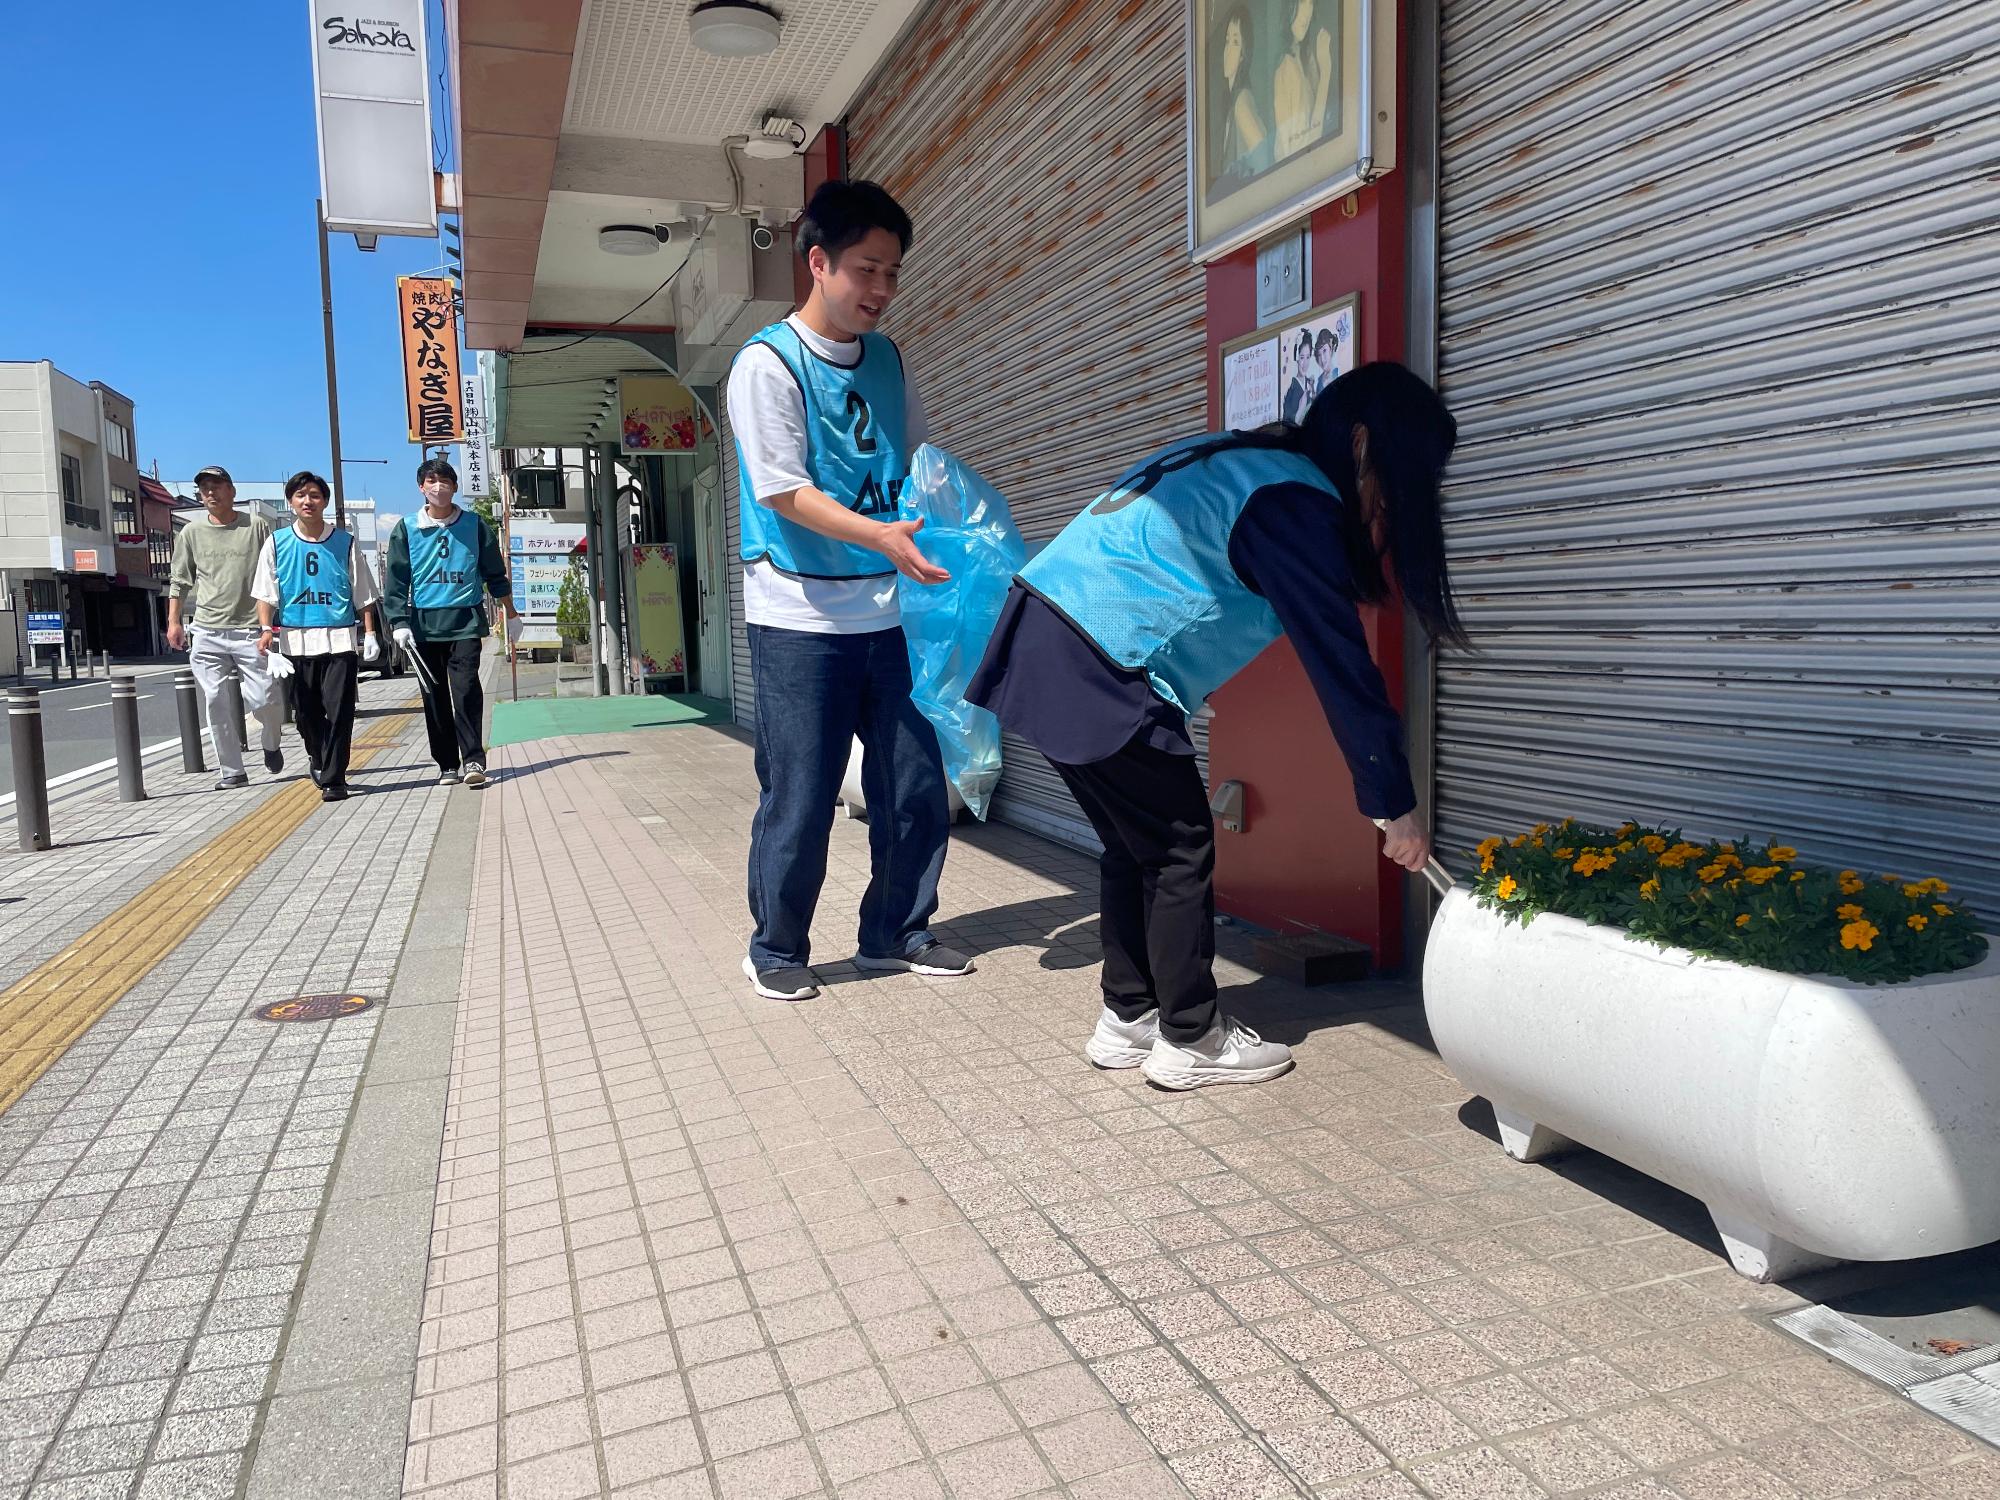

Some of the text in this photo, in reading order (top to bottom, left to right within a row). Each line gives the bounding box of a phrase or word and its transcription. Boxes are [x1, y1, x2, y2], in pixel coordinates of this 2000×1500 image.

[323, 17, 416, 51] Sahara
[411, 291, 443, 306] 焼肉
[412, 306, 455, 440] やなぎ屋
[847, 390, 878, 454] 2
[850, 469, 904, 516] ALE
[437, 535, 449, 559] 3
[305, 551, 319, 577] 6
[424, 567, 464, 584] ALEC
[291, 587, 333, 606] ALEC
